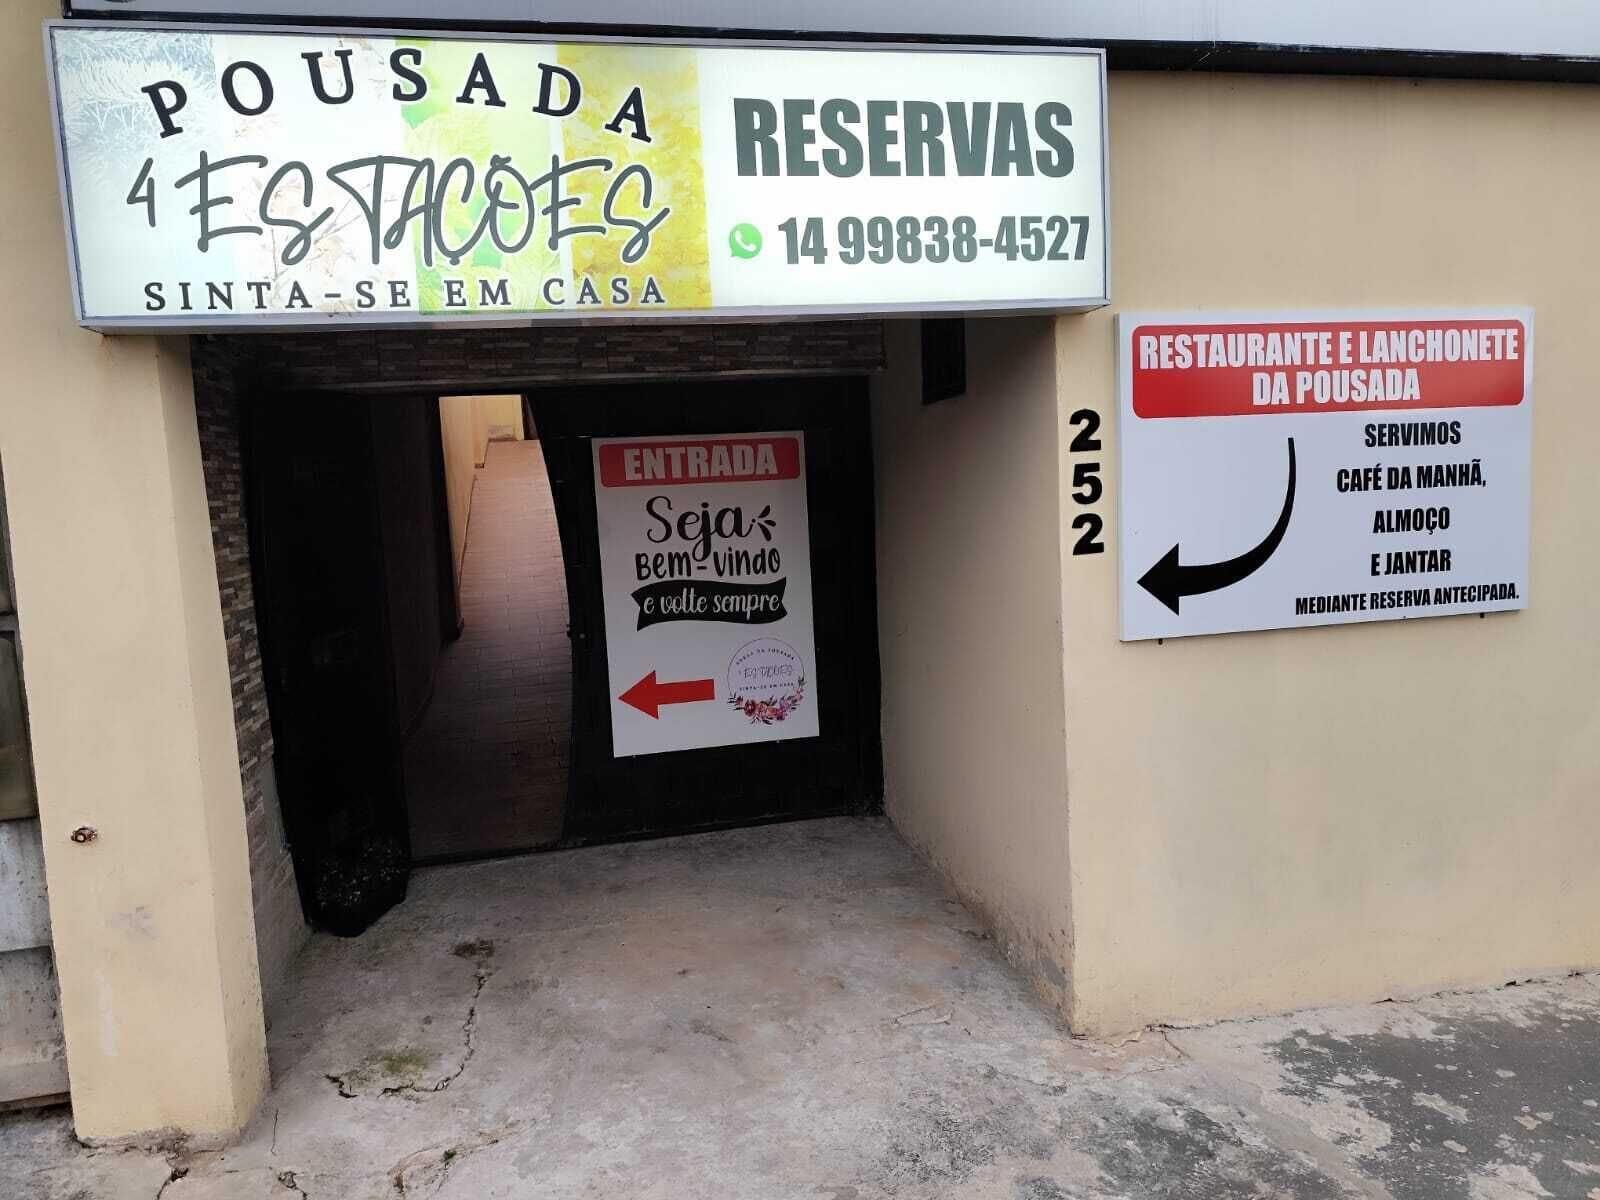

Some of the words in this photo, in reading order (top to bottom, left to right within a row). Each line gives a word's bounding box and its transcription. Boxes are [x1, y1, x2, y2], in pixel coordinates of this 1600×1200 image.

[142, 48, 652, 142] POUSADA
[734, 98, 1075, 178] RESERVAS
[126, 158, 155, 227] 4
[174, 150, 670, 267] ESTAÇÕES
[778, 217, 828, 264] 14
[837, 215, 1090, 265] 99838-4527
[143, 280, 411, 310] SINTA-SE
[445, 279, 511, 307] EM
[542, 277, 666, 305] CASA
[1139, 331, 1333, 370] RESTAURANTE
[1339, 330, 1353, 364] E
[1359, 328, 1519, 363] LANCHONETE
[1252, 372, 1289, 406] DA
[1296, 368, 1421, 404] POUSADA
[1364, 421, 1461, 448] SERVIMOS
[623, 444, 778, 481] ENTRADA
[1337, 463, 1382, 493] CAFÉ
[1387, 466, 1413, 490] DA
[1416, 459, 1486, 489] MANHÃ,
[646, 496, 756, 562] Seja
[1373, 507, 1451, 536] ALMOÇO
[1370, 553, 1381, 576] E
[1384, 549, 1452, 575] JANTAR
[643, 594, 655, 615] e
[660, 587, 709, 614] volte
[712, 592, 780, 621] sempre
[1295, 593, 1367, 615] MEDIANTE
[1370, 588, 1431, 611] RESERVA
[1433, 583, 1520, 606] ANTECIPADA.
